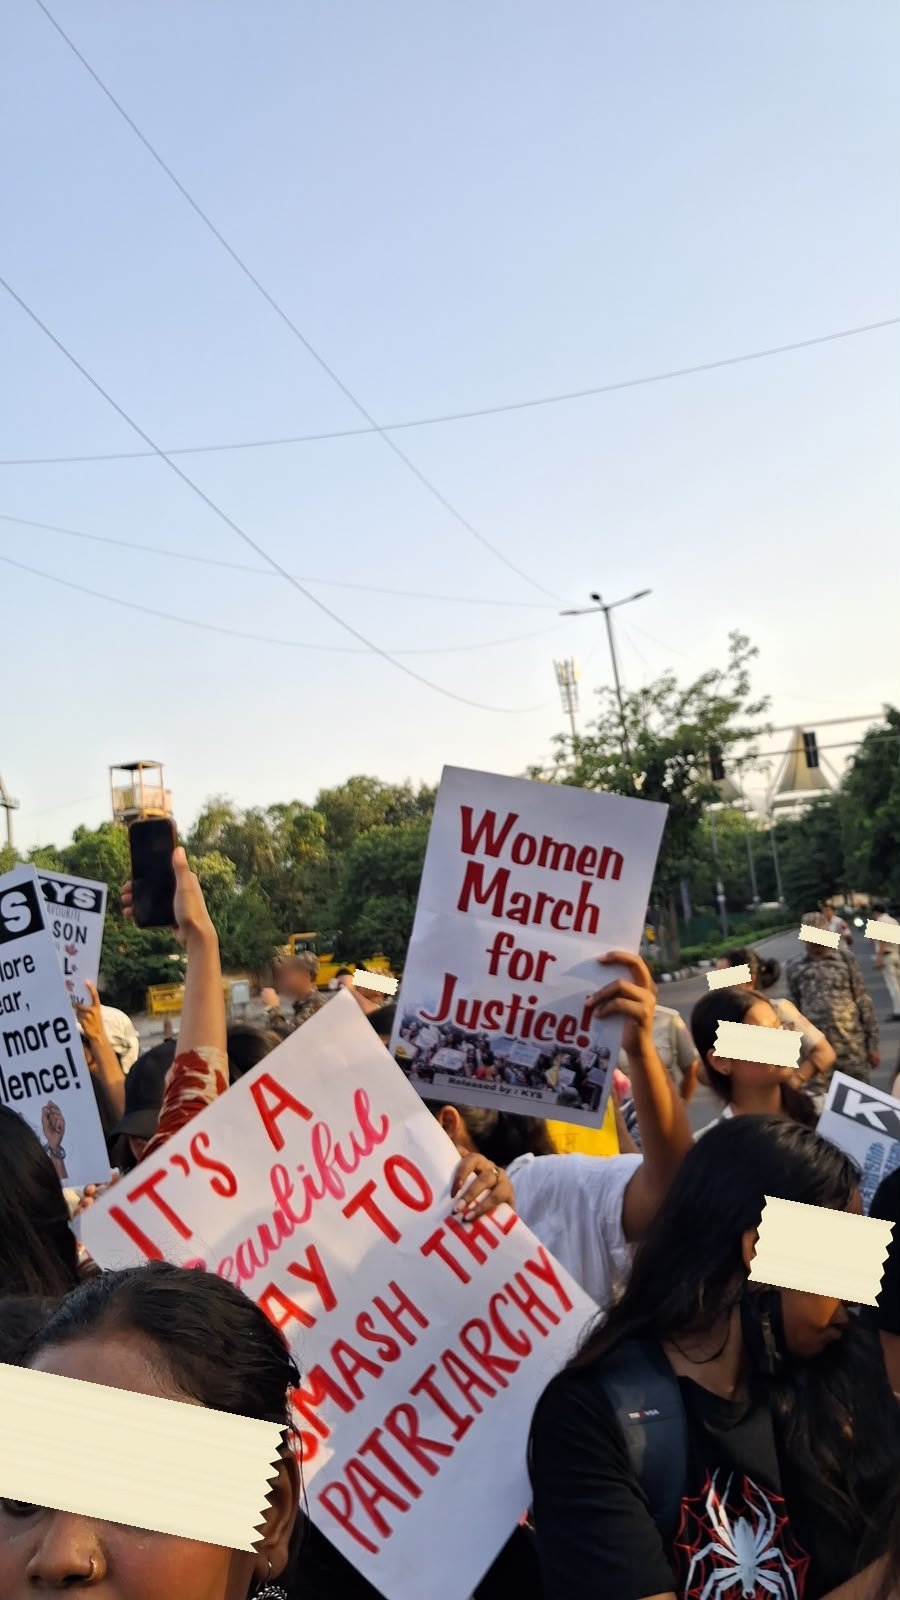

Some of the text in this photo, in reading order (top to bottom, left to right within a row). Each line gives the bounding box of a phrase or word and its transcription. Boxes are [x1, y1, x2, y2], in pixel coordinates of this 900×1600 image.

[459, 805, 625, 881] Women
[40, 879, 97, 909] YS
[456, 860, 600, 934] March
[486, 932, 557, 983] for
[3, 1017, 71, 1058] more
[419, 972, 595, 1048] Justice!
[0, 1047, 81, 1103] lence!
[448, 1077, 497, 1091] Released
[499, 1084, 511, 1094] by
[521, 1090, 544, 1099] KYS
[841, 1088, 900, 1132] K
[108, 1072, 314, 1260] IT'S A
[183, 1088, 389, 1288] eautiful
[257, 1154, 434, 1350] AY TO
[318, 1245, 574, 1554] PATRIARCHY
